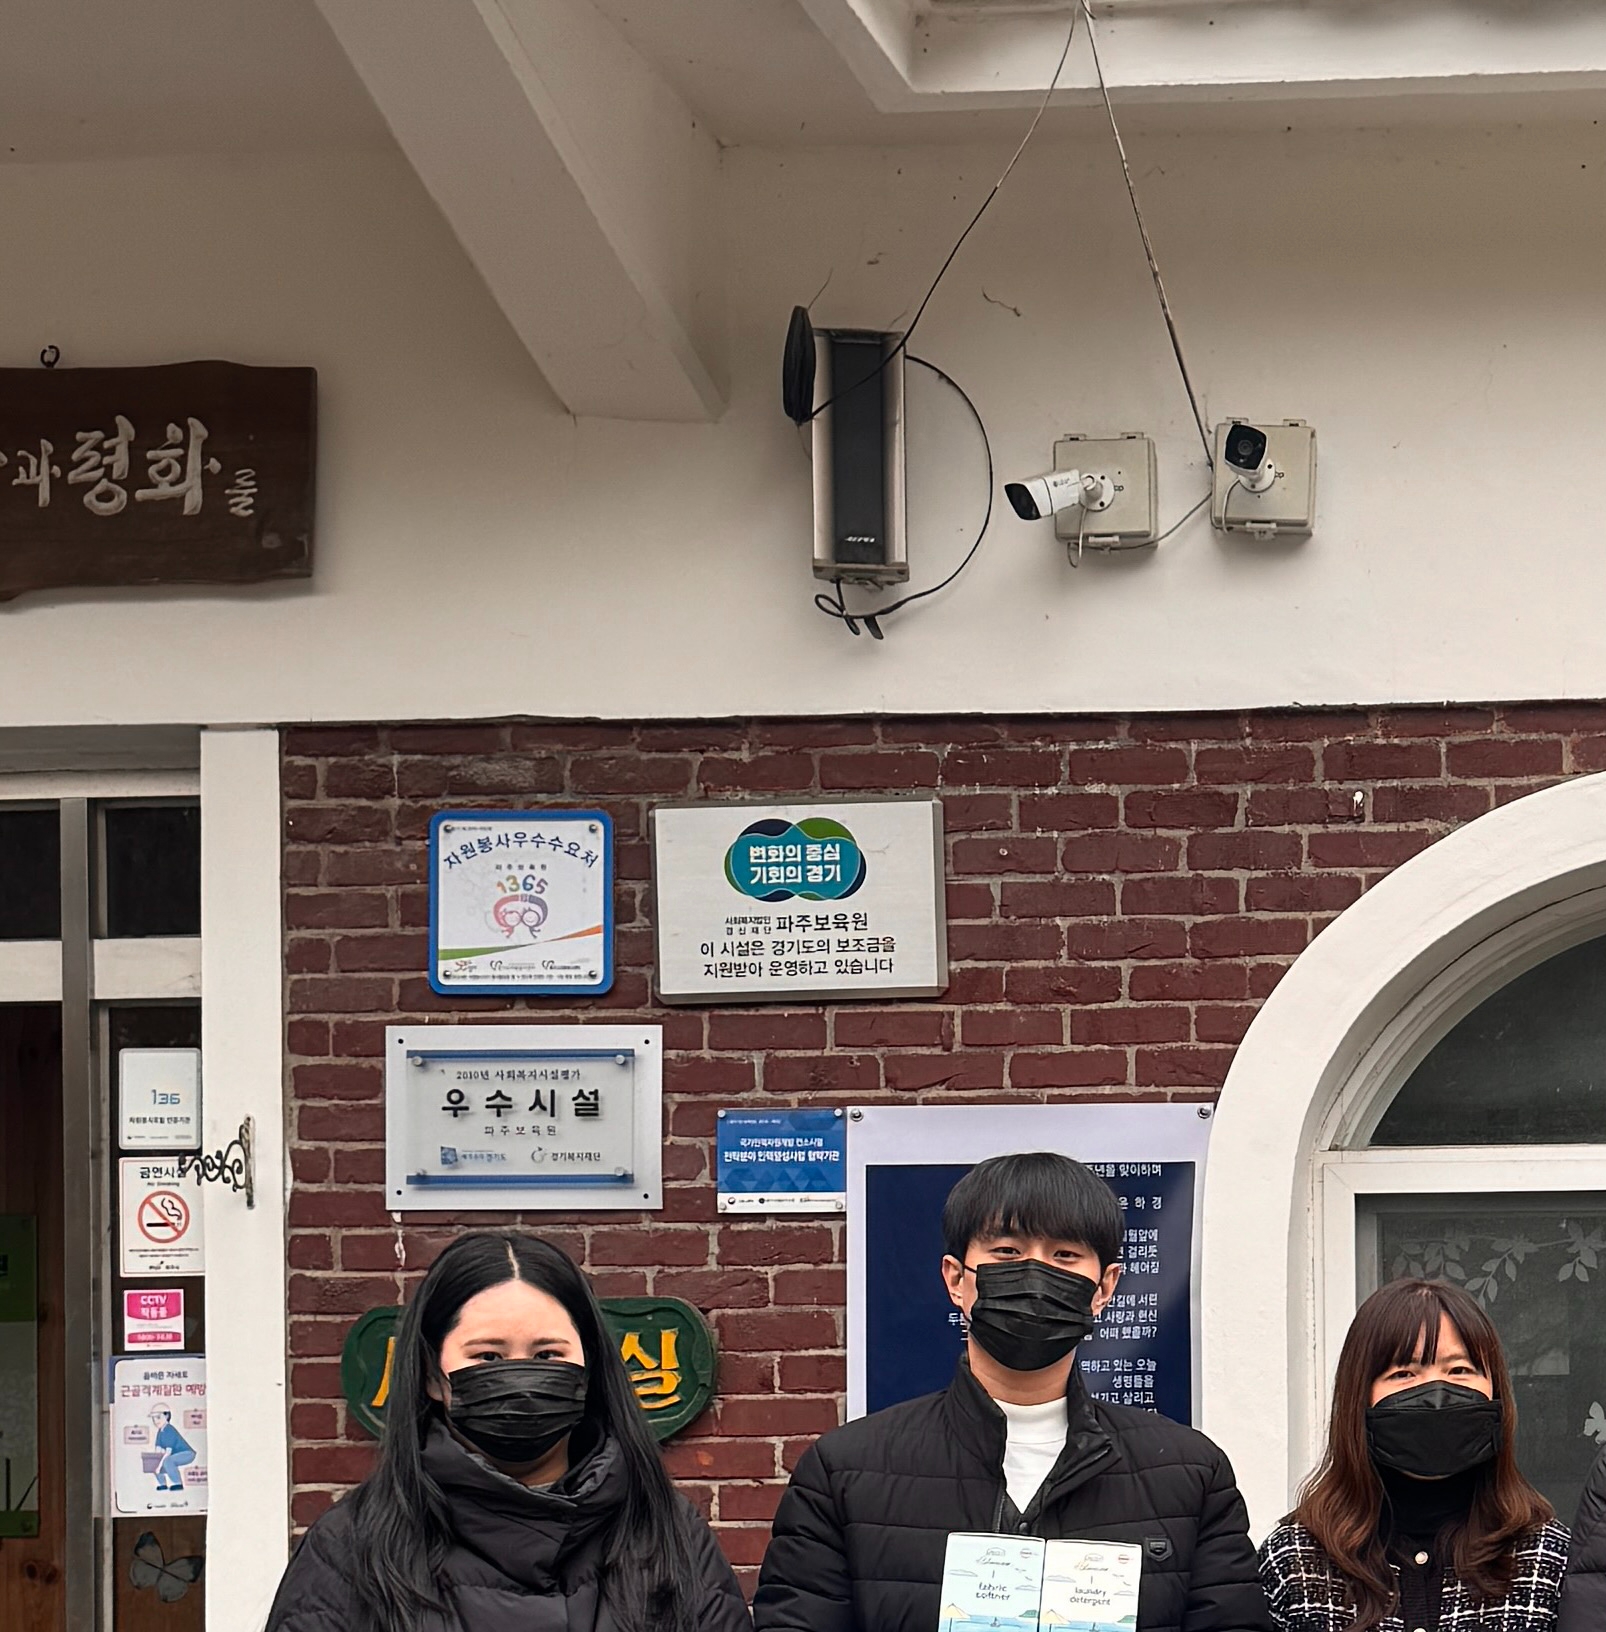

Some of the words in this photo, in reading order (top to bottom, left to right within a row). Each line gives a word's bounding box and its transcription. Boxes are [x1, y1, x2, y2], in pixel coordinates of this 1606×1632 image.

[750, 845, 801, 863] 변화의
[806, 843, 840, 861] 중심
[496, 874, 548, 894] 1365
[750, 866, 802, 885] 기회의
[806, 864, 842, 883] 경기
[776, 912, 868, 933] 파주보육원
[701, 942, 714, 957] 이
[721, 940, 765, 956] 시설은
[771, 939, 830, 955] 경기도의
[836, 936, 896, 953] 보조금을
[704, 961, 763, 978] 지원받아
[769, 960, 829, 976] 운영하고
[834, 958, 893, 974] 있습니다
[456, 1069, 490, 1081] 2010년
[140, 1295, 167, 1305] CCTV
